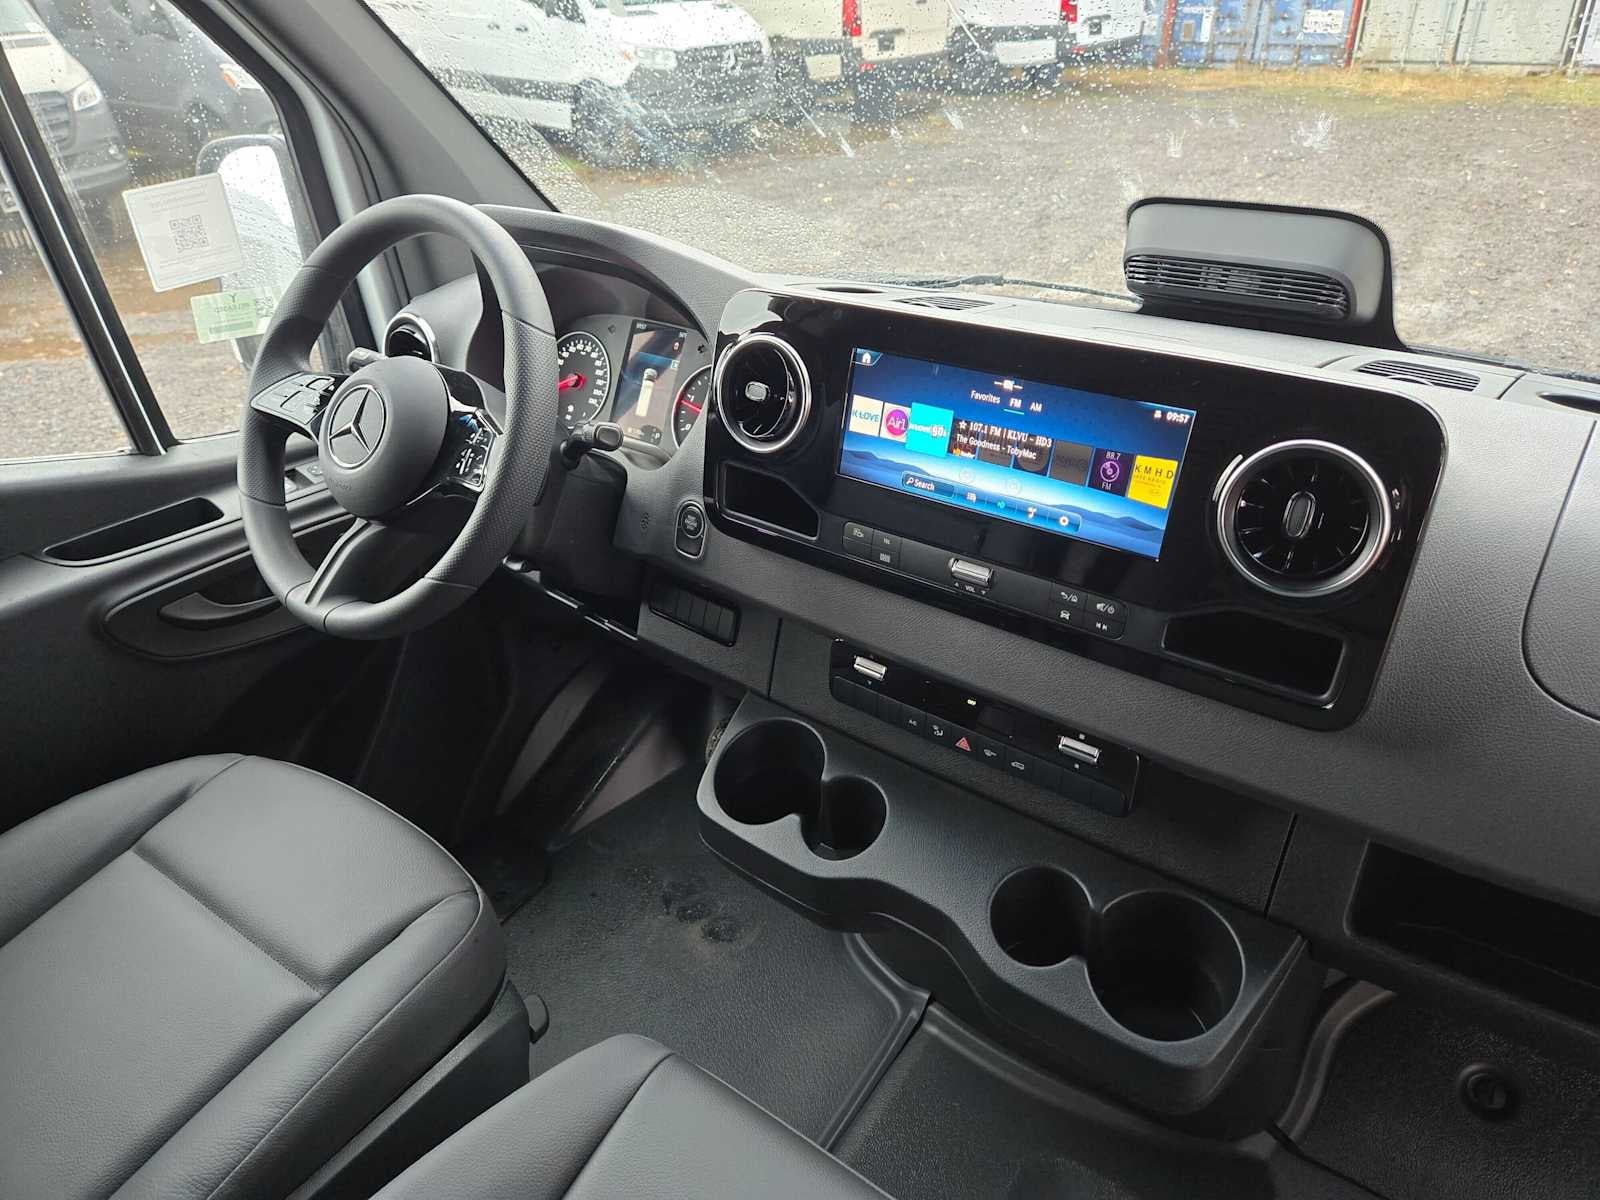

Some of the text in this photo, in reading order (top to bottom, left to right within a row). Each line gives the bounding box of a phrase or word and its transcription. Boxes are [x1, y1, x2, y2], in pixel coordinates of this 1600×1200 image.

[971, 390, 1000, 404] Favorites
[1010, 398, 1022, 408] FM
[1030, 402, 1042, 413] AM
[887, 416, 905, 431] Air1
[1166, 411, 1190, 424] 09:57
[969, 423, 988, 434] 107.1
[990, 425, 1001, 436] FM
[1008, 429, 1029, 442] KLVU
[1035, 437, 1052, 448] HD3
[956, 434, 968, 444] The
[969, 436, 1000, 451] Goodness
[1008, 445, 1036, 460] TobyMac
[1105, 451, 1121, 460] 88.7
[914, 479, 935, 491] Search
[1101, 481, 1112, 491] FM
